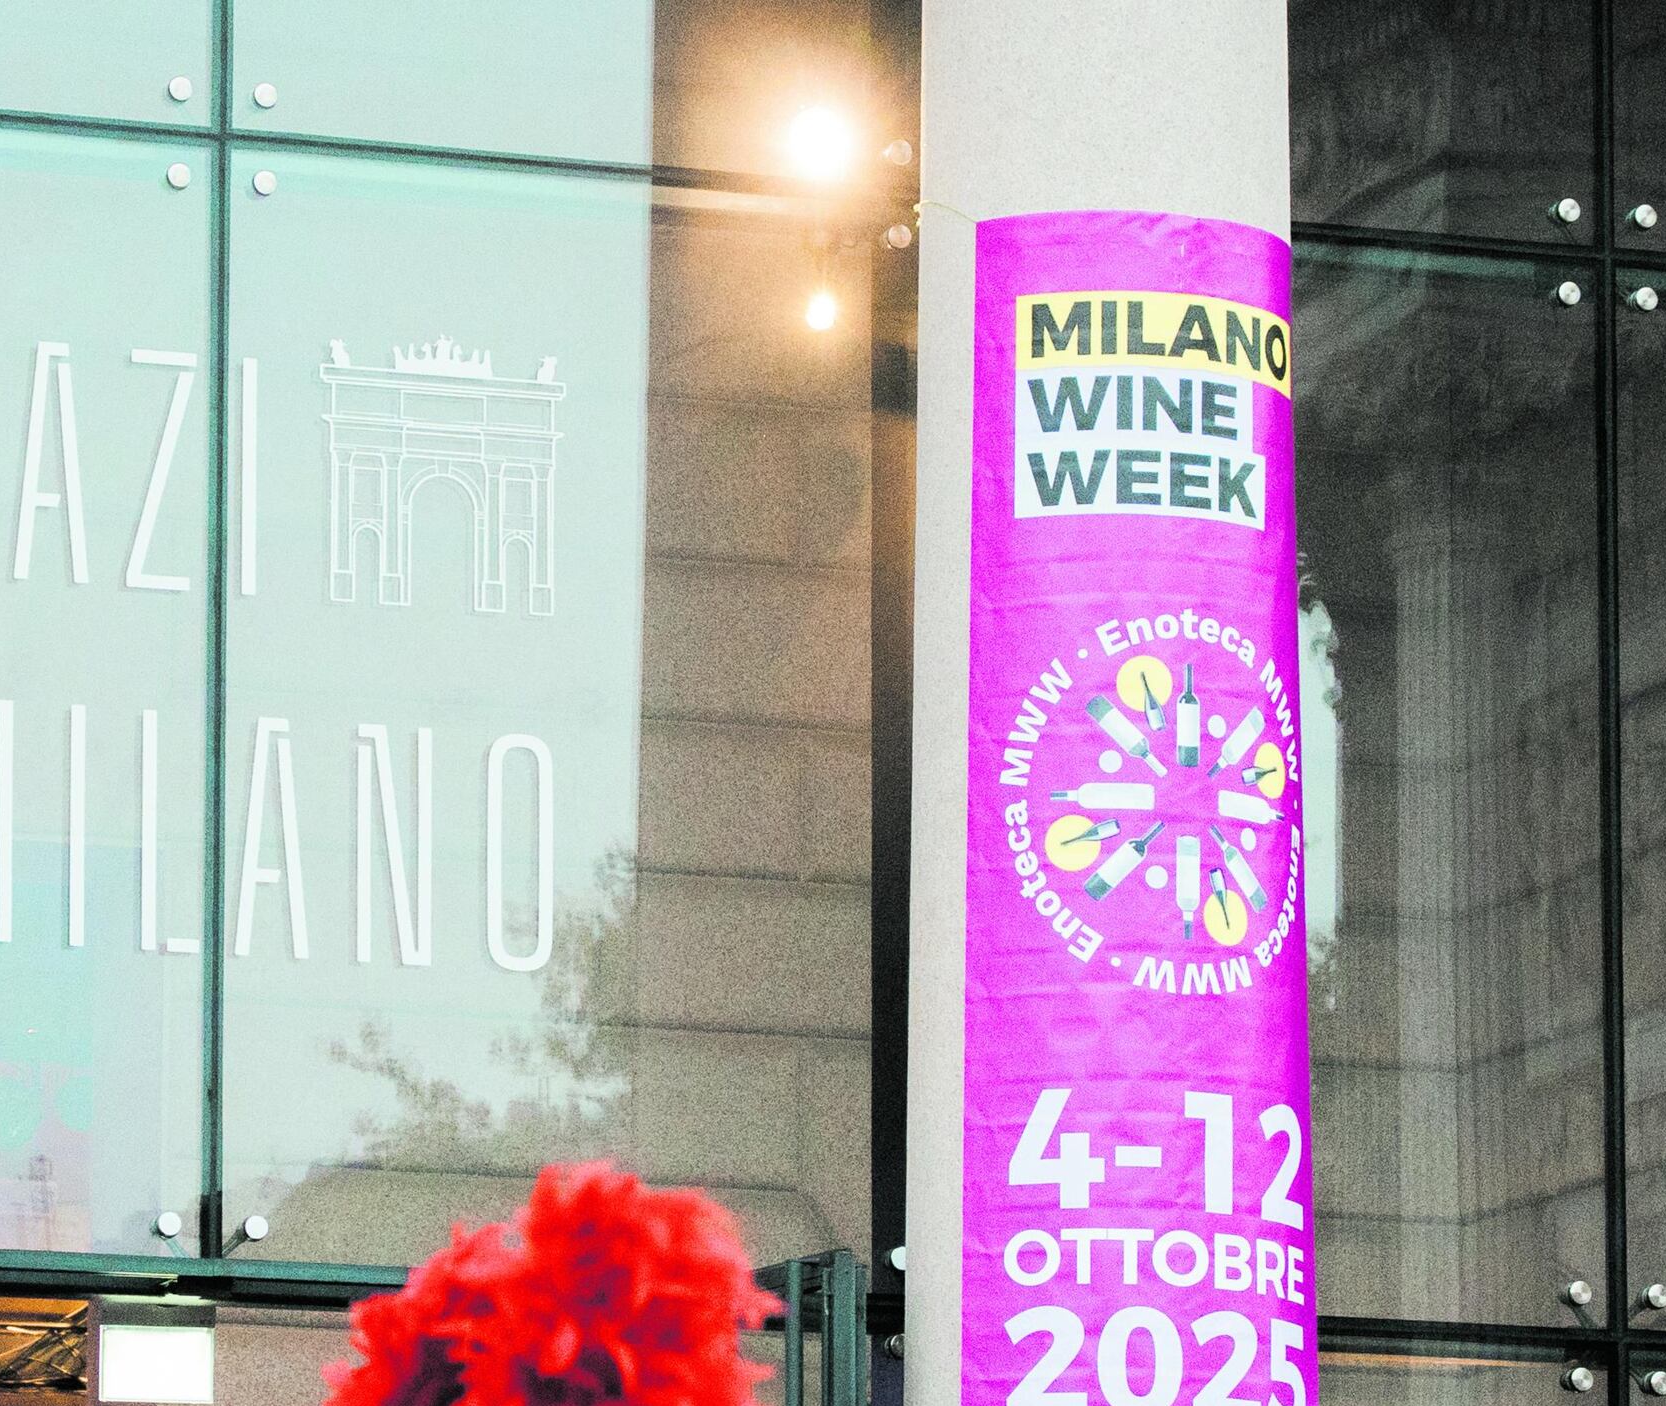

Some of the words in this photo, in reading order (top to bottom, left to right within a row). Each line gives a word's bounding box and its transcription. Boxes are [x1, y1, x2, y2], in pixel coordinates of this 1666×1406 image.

[1031, 300, 1286, 381] MILANO
[1027, 375, 1238, 440] WINE
[1027, 449, 1257, 519] WEEK
[999, 657, 1073, 787] MWW
[1095, 608, 1256, 668] Enoteca
[1259, 658, 1298, 783] MWW
[1004, 799, 1104, 964] Enoteca
[1253, 823, 1301, 967] Enoteca
[1133, 955, 1253, 995] MWW
[1009, 1088, 1303, 1231] 4-12
[1003, 1228, 1304, 1306] OTTOBRE
